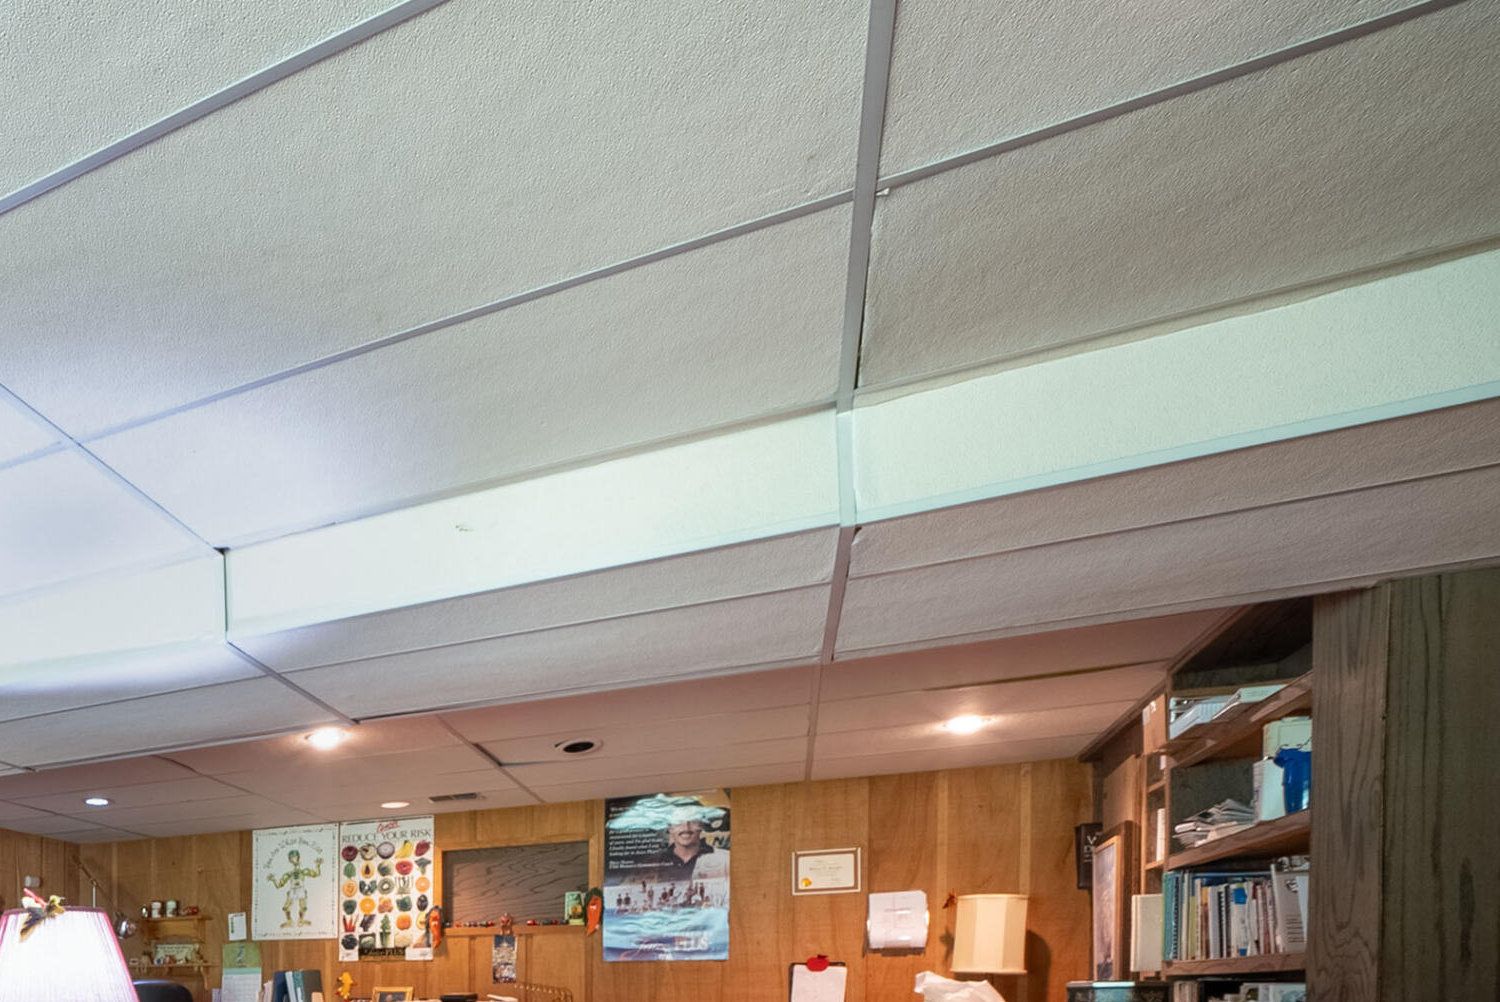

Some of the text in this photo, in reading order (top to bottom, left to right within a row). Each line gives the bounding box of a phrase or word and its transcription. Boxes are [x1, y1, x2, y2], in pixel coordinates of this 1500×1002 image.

[342, 827, 431, 843] REDUCE YOUR RISK
